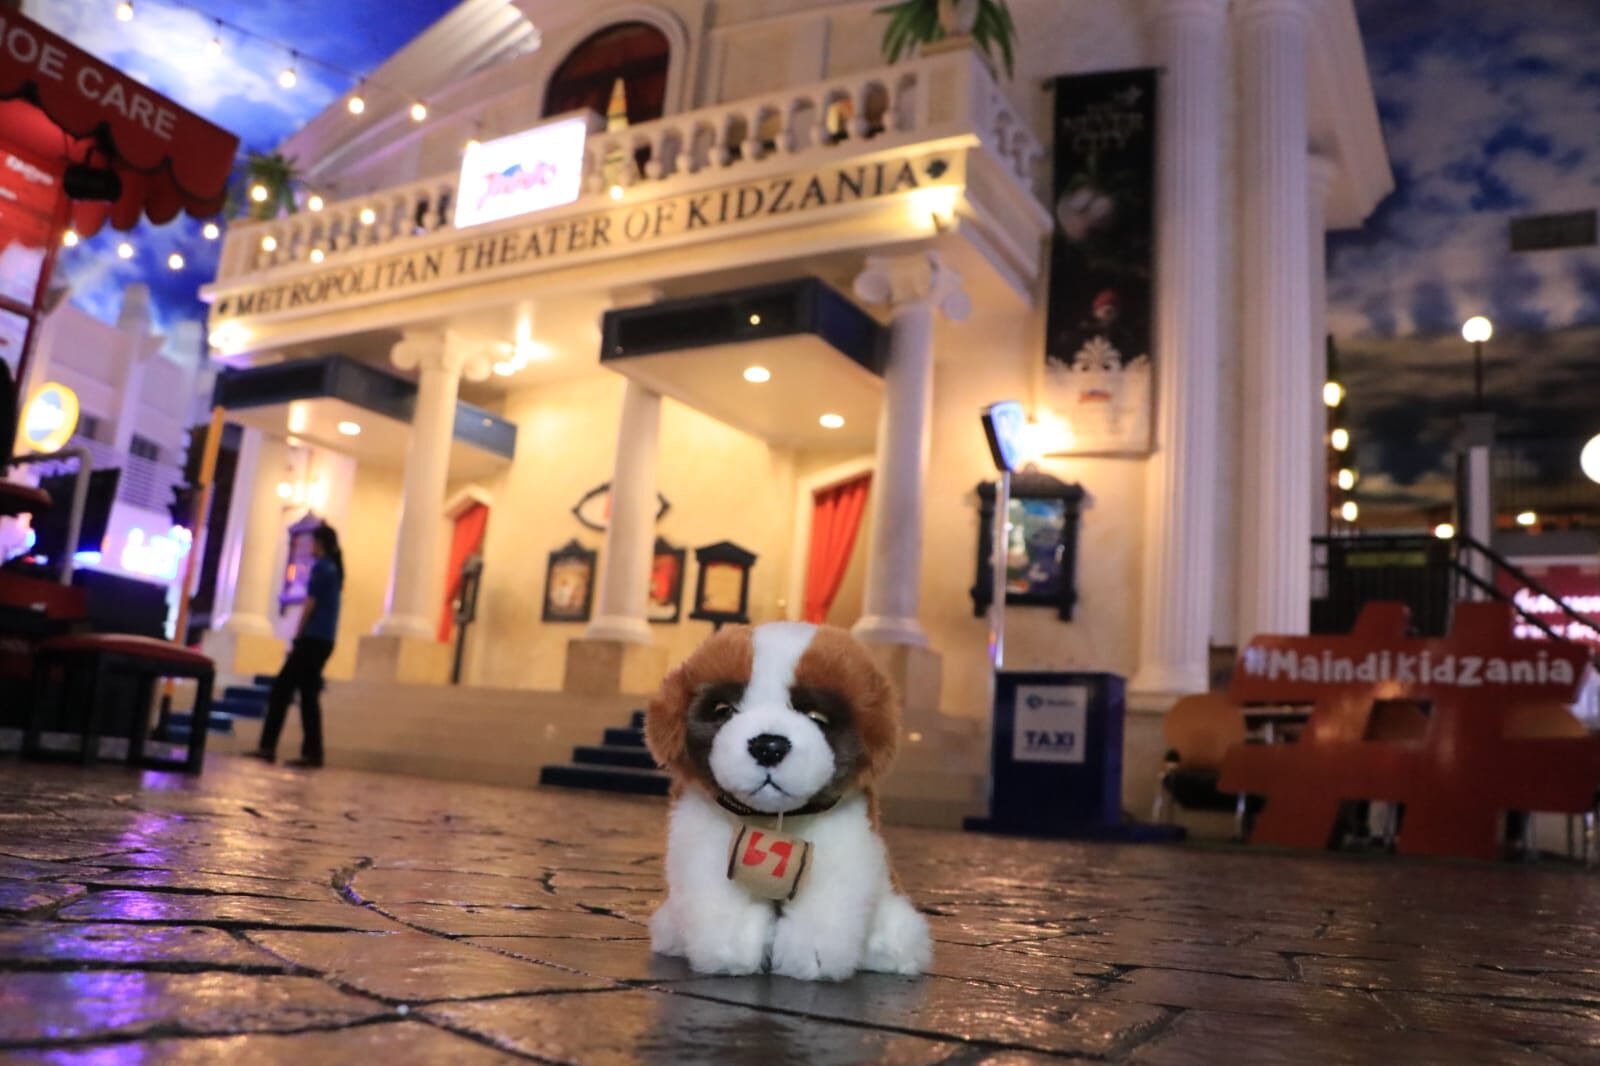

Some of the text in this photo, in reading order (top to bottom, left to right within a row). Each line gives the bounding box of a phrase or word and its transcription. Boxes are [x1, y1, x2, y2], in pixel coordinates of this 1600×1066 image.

[78, 66, 177, 140] CARE
[236, 161, 919, 315] METROPOLITAN THEATER OF KIDZANIA
[1024, 731, 1075, 746] TAXI
